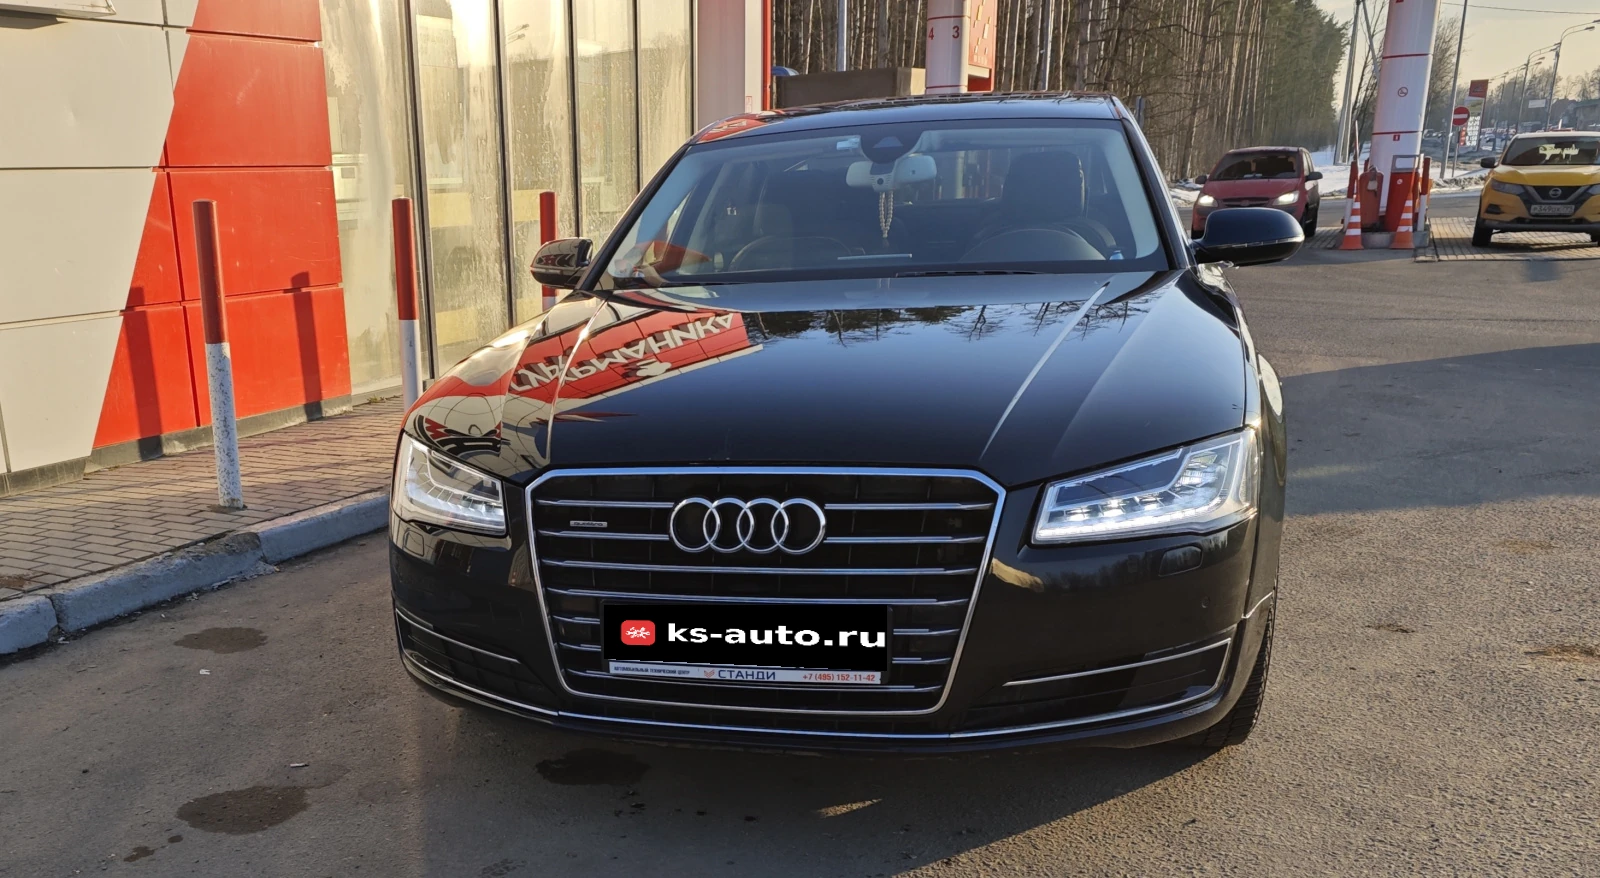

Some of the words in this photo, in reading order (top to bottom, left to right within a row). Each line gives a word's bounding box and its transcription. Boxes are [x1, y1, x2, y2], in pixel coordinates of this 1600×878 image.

[928, 27, 935, 40] 4
[952, 25, 960, 39] 3
[718, 669, 776, 681] СТАНДИ
[802, 673, 813, 681] +7
[814, 673, 835, 682] (495)
[836, 673, 876, 682] 152-11-42
